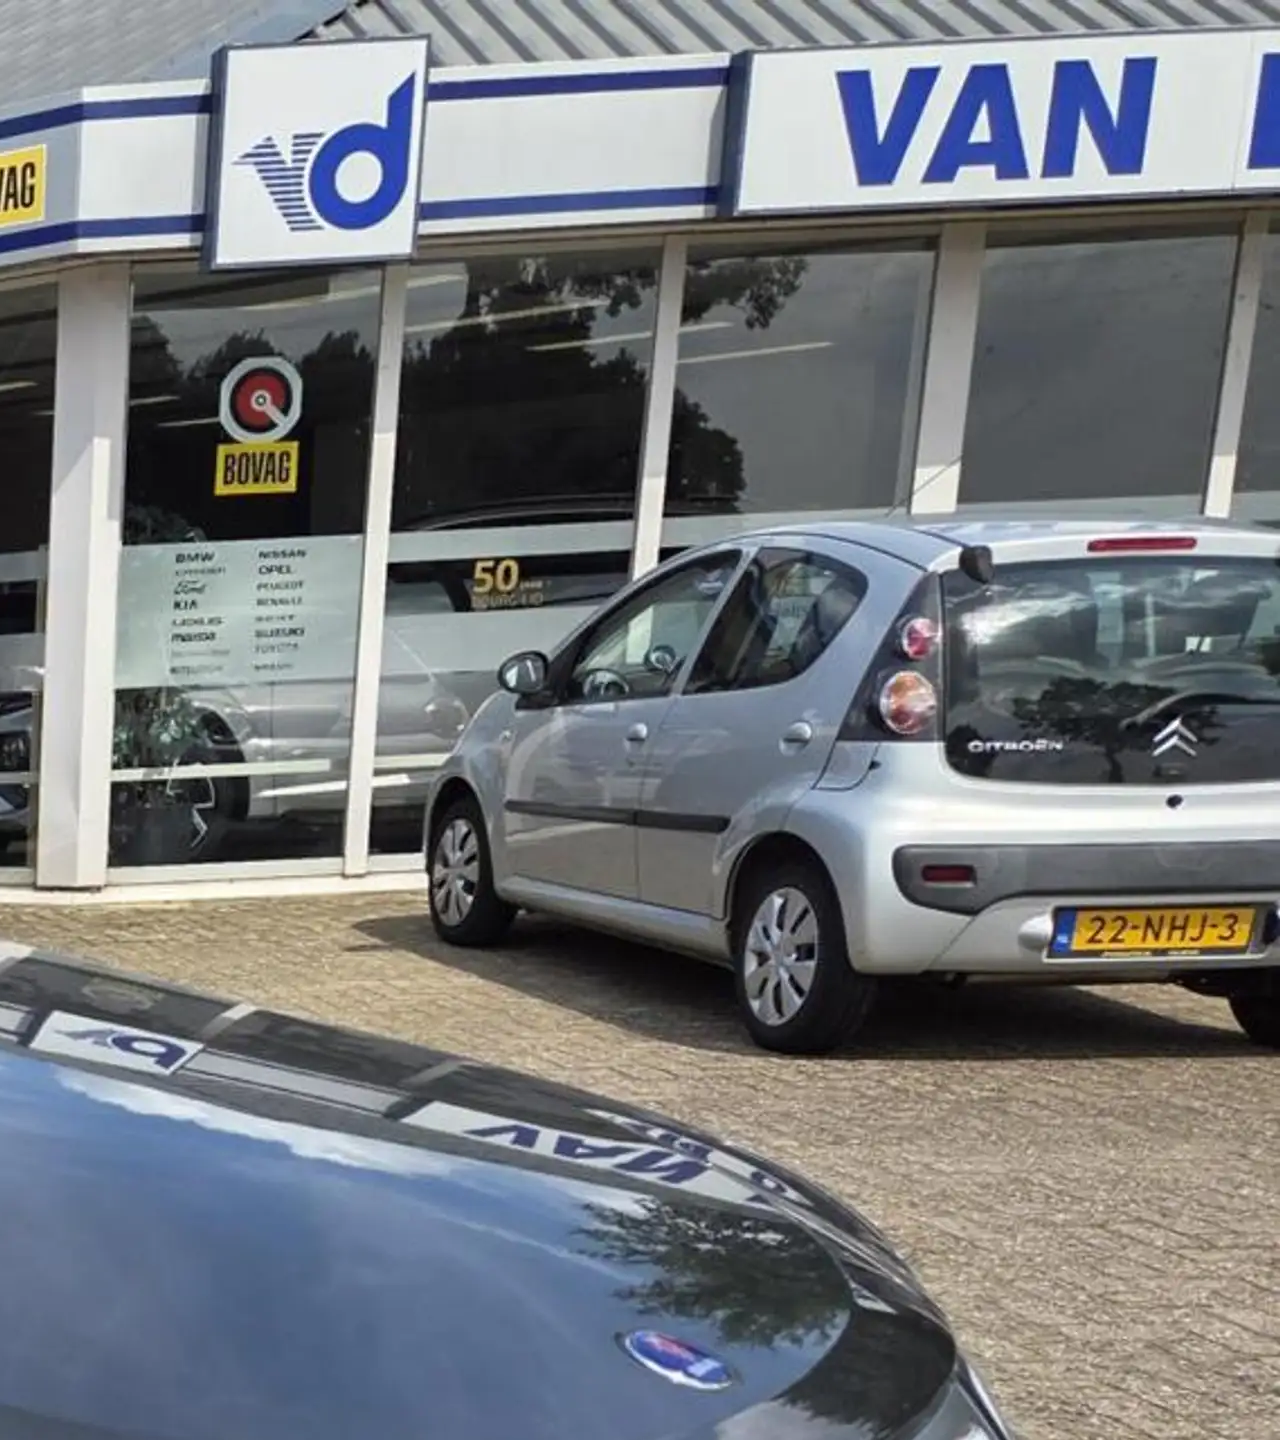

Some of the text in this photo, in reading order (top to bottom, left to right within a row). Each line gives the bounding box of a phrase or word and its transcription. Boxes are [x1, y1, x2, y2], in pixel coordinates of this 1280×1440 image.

[835, 56, 1158, 187] VAN
[222, 450, 292, 486] BOVAG
[175, 552, 215, 564] BMW
[258, 549, 307, 560] NISSAN
[258, 564, 293, 575] OPEL
[472, 558, 520, 594] 50
[173, 599, 198, 611] KIA
[1085, 912, 1240, 945] 22-NHJ-3
